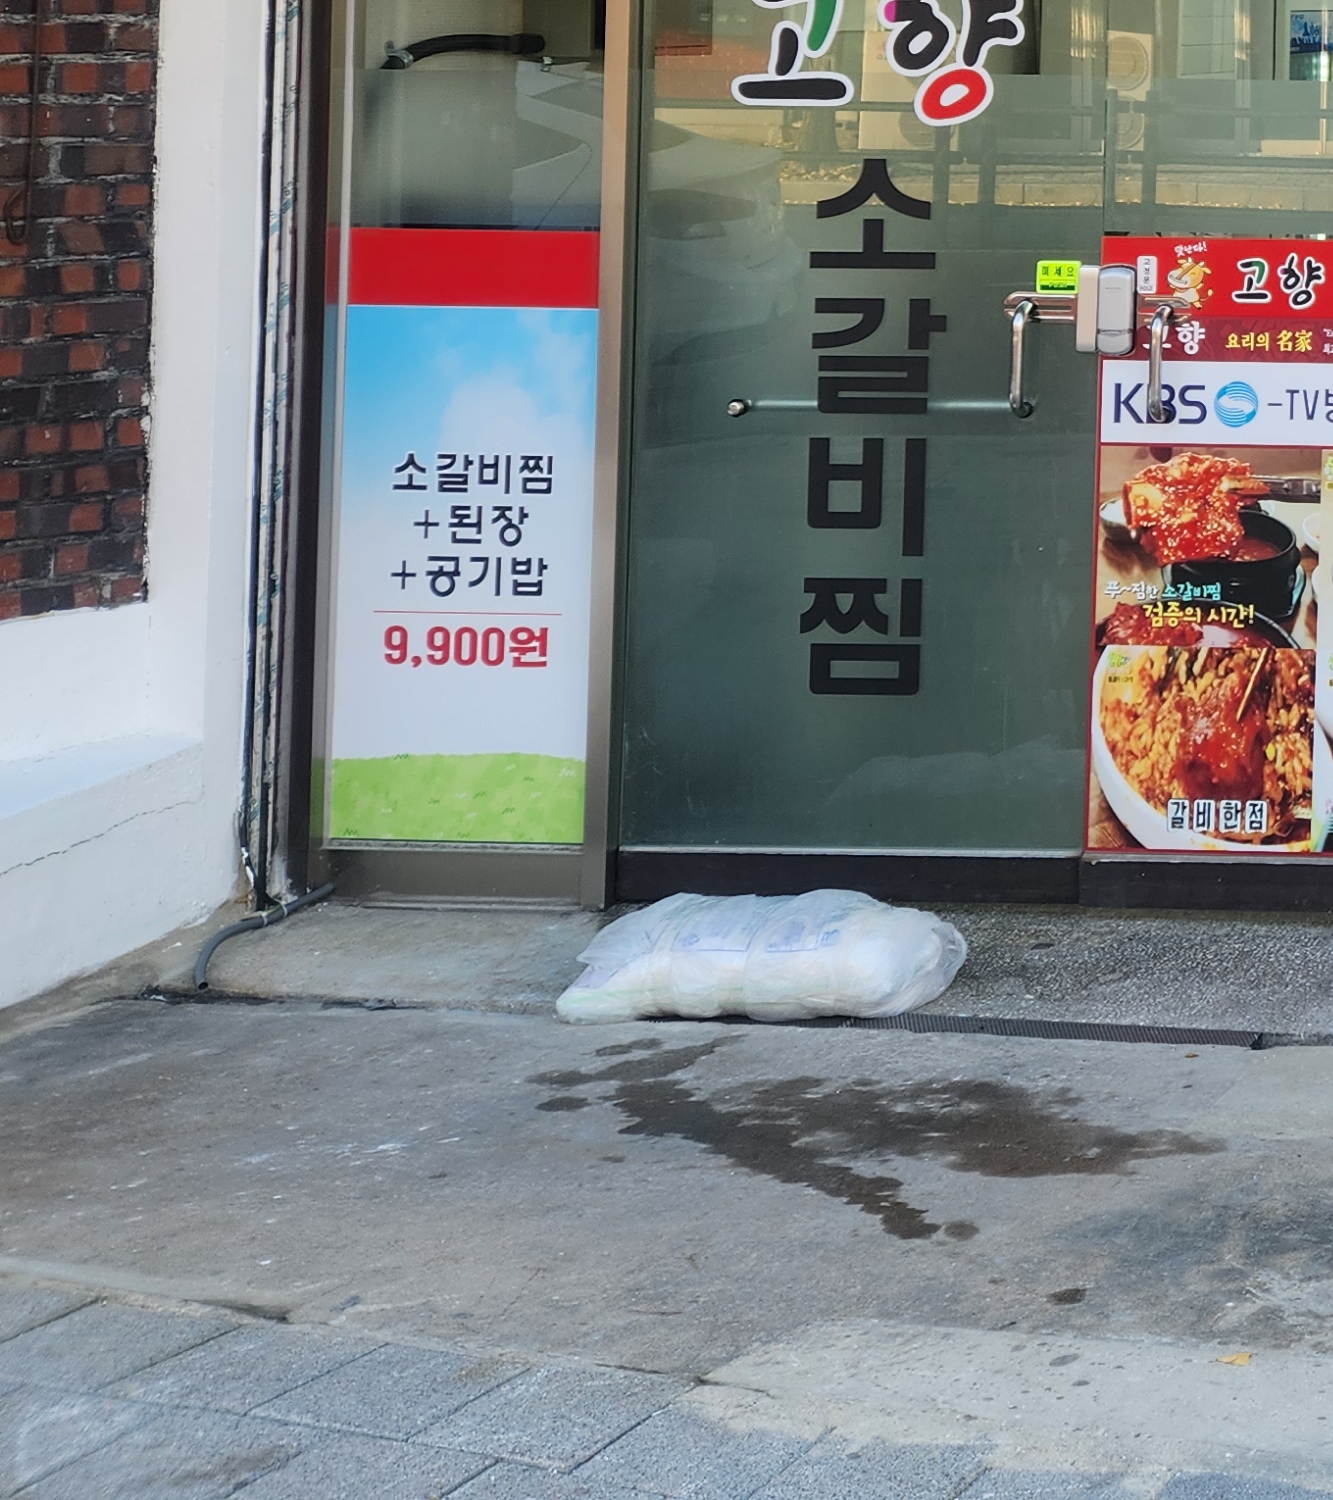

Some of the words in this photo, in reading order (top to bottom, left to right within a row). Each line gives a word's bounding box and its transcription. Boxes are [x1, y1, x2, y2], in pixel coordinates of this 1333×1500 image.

[1231, 252, 1325, 311] 고향
[1225, 331, 1270, 352] 요리의
[1276, 329, 1314, 353] 名家
[799, 156, 948, 697] 소갈비찜
[392, 451, 555, 496] 소갈비찜
[413, 505, 530, 548] +된장
[390, 556, 549, 598] +공기밥
[1161, 581, 1222, 602] 소갈비찜
[1143, 604, 1202, 628] 검증의
[1207, 604, 1255, 629] 시간!
[383, 625, 550, 670] 9,900원
